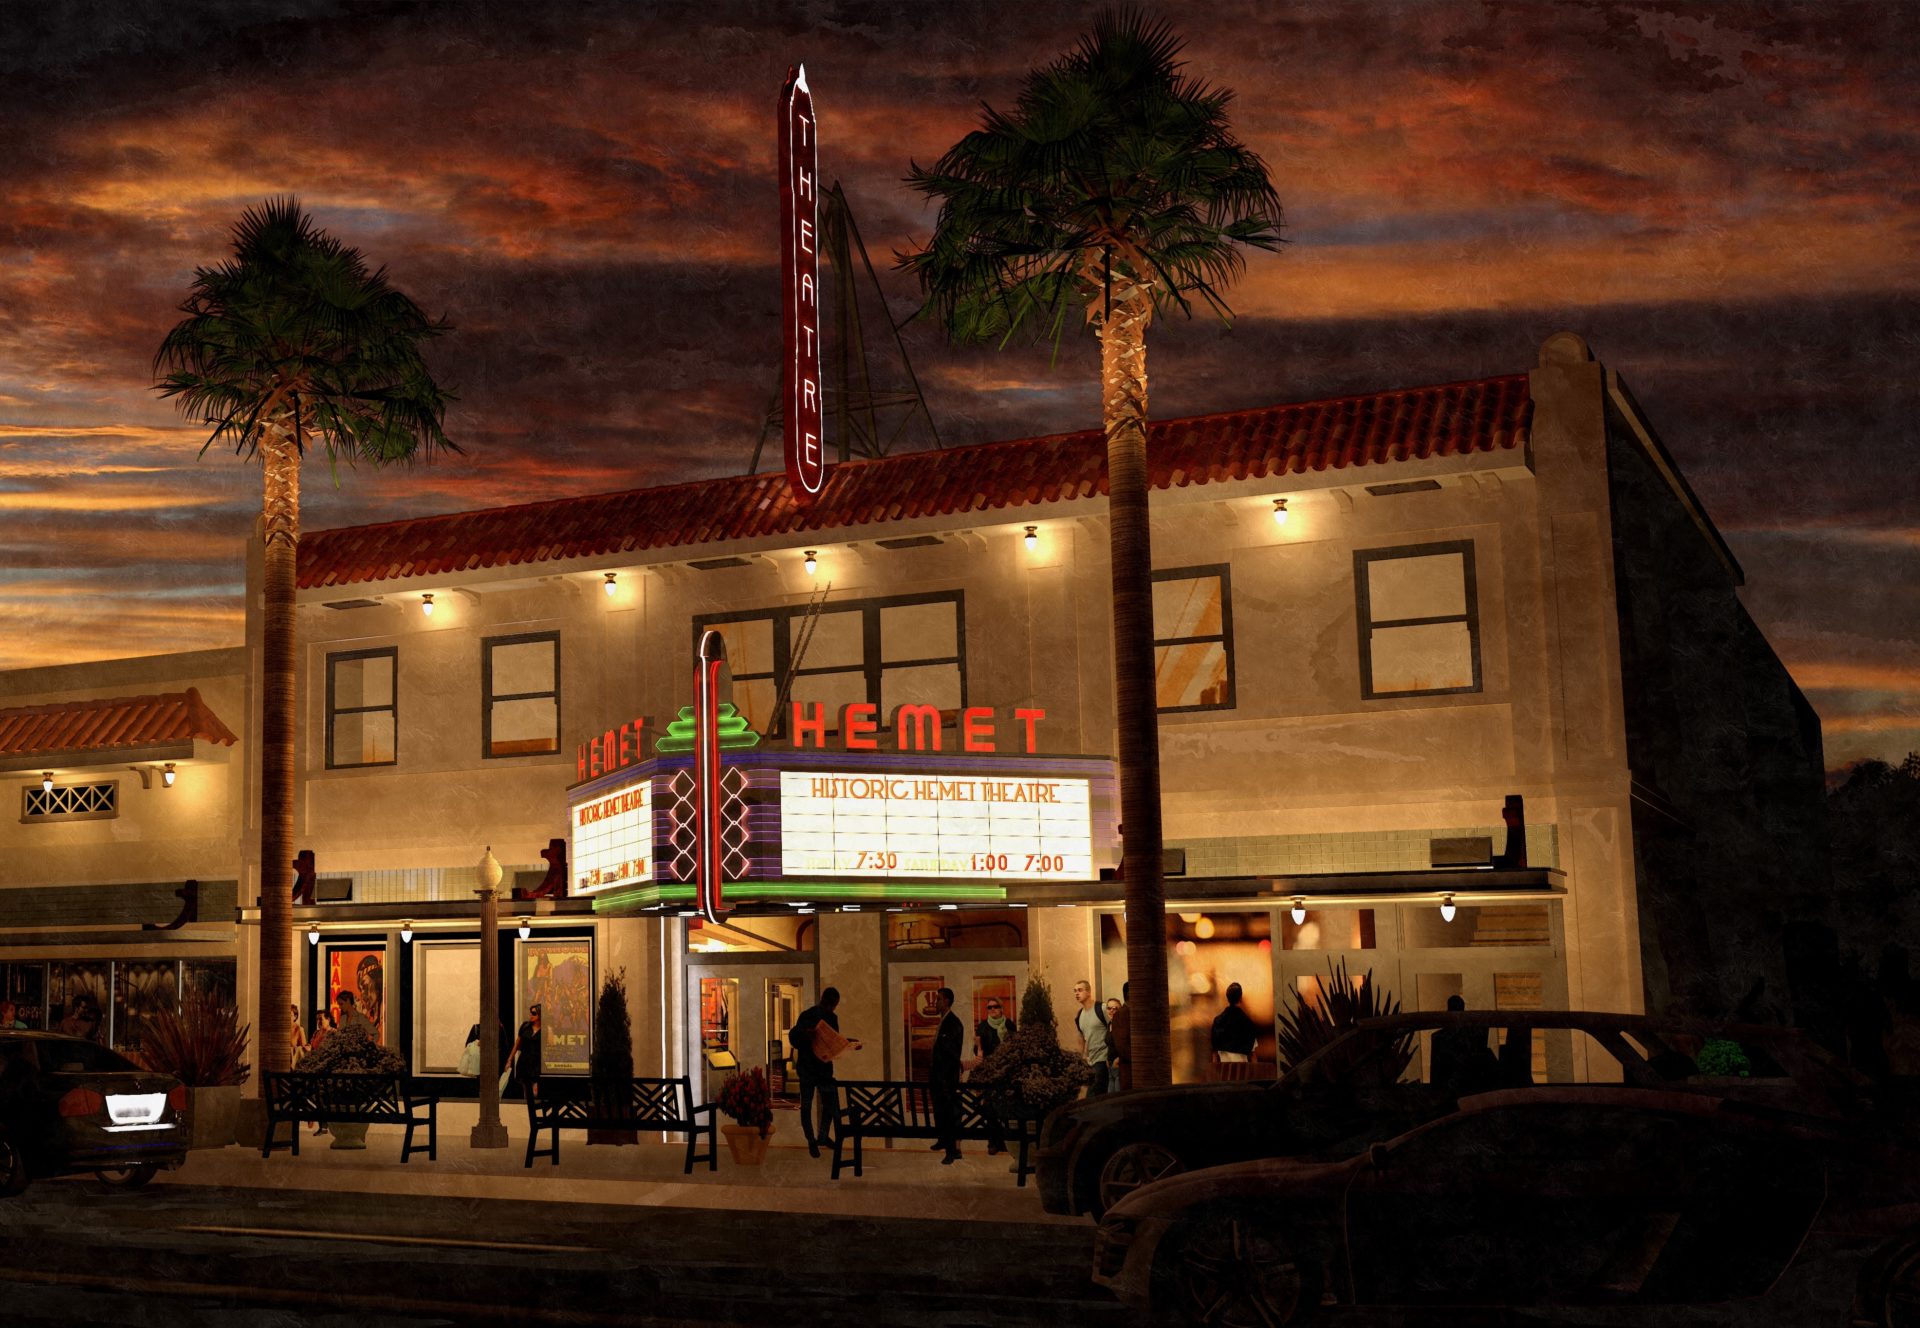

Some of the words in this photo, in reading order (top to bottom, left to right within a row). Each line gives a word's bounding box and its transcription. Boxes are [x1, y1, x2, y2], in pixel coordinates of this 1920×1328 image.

[799, 114, 818, 468] THEATRE
[577, 716, 644, 782] HEMET
[791, 700, 1046, 754] HEMET
[811, 777, 909, 800] HISTORIC
[913, 780, 976, 801] HEMET
[980, 781, 1061, 804] THEATRE
[855, 851, 897, 870] 7:30
[970, 853, 1008, 872] 1:00
[1023, 854, 1064, 873] 7:00
